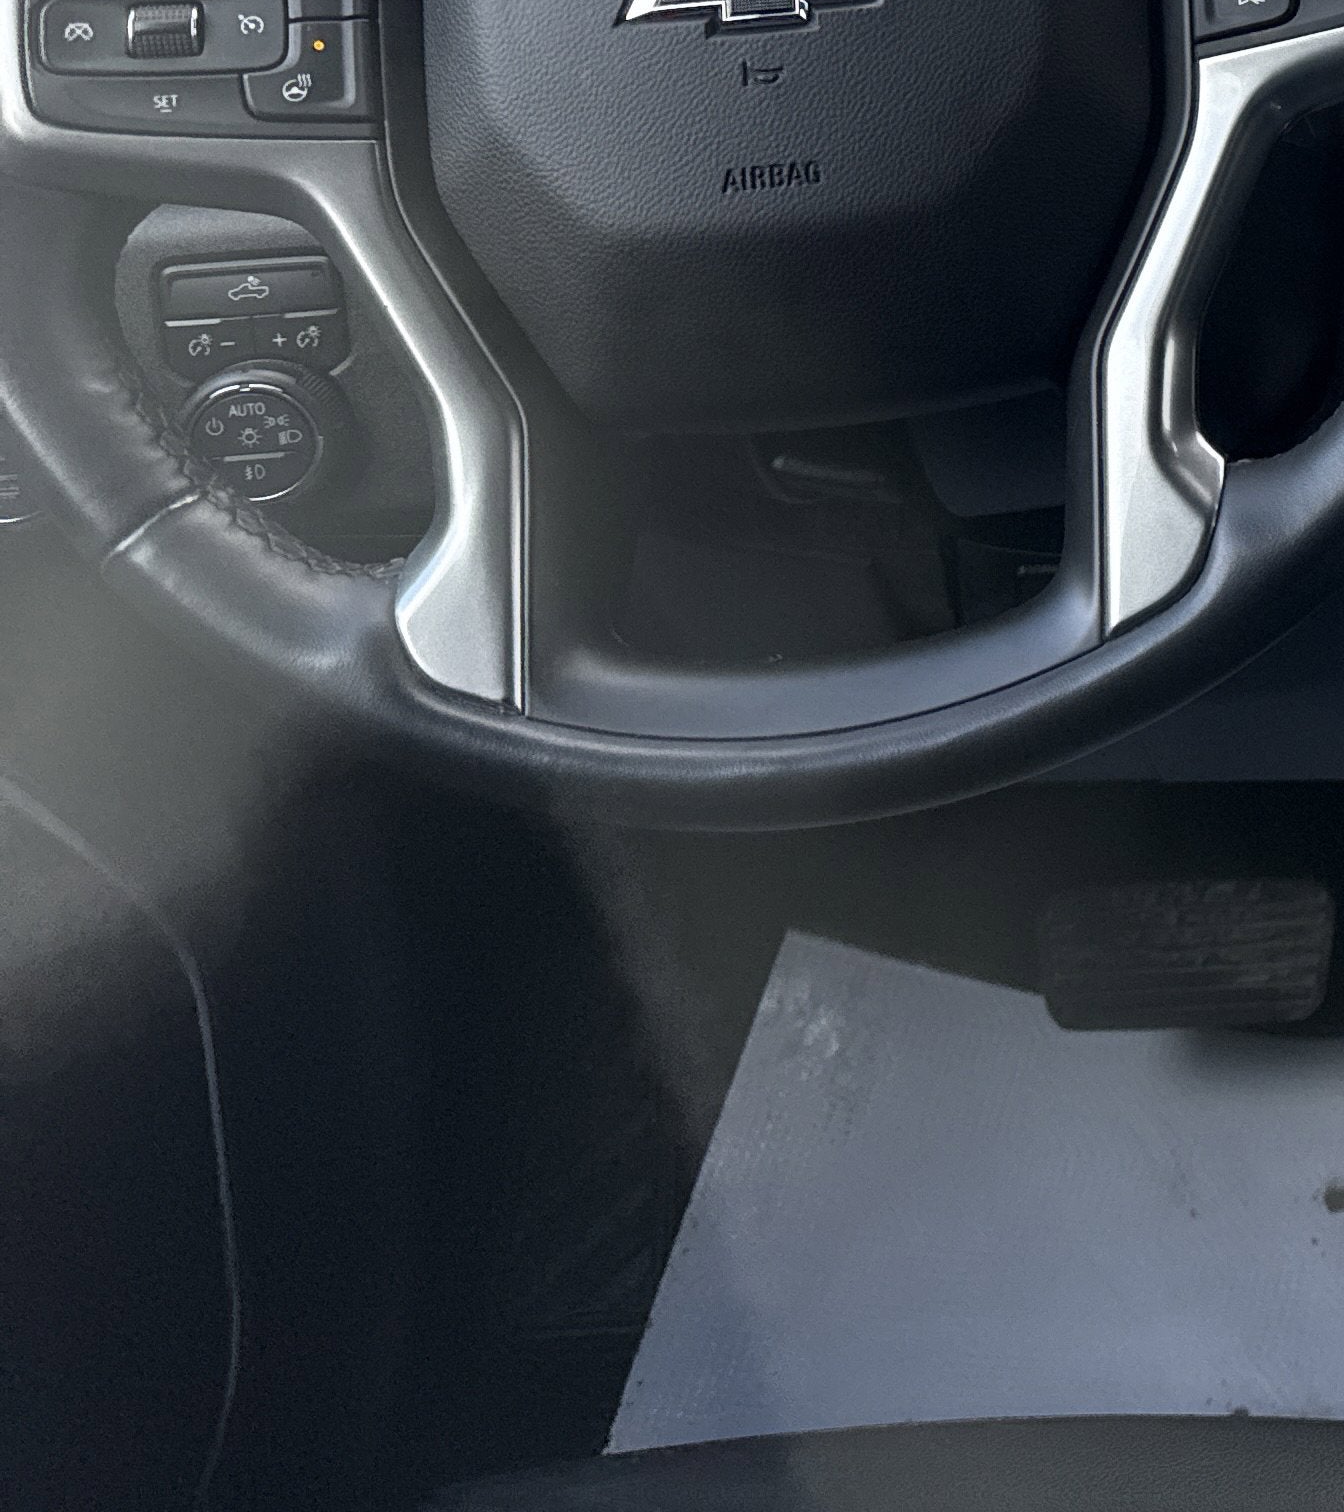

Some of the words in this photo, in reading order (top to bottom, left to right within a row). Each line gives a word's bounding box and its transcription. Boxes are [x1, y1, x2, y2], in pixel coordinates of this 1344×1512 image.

[153, 95, 178, 108] SET
[721, 161, 822, 194] AIRBAG
[229, 402, 265, 417] AUTO
